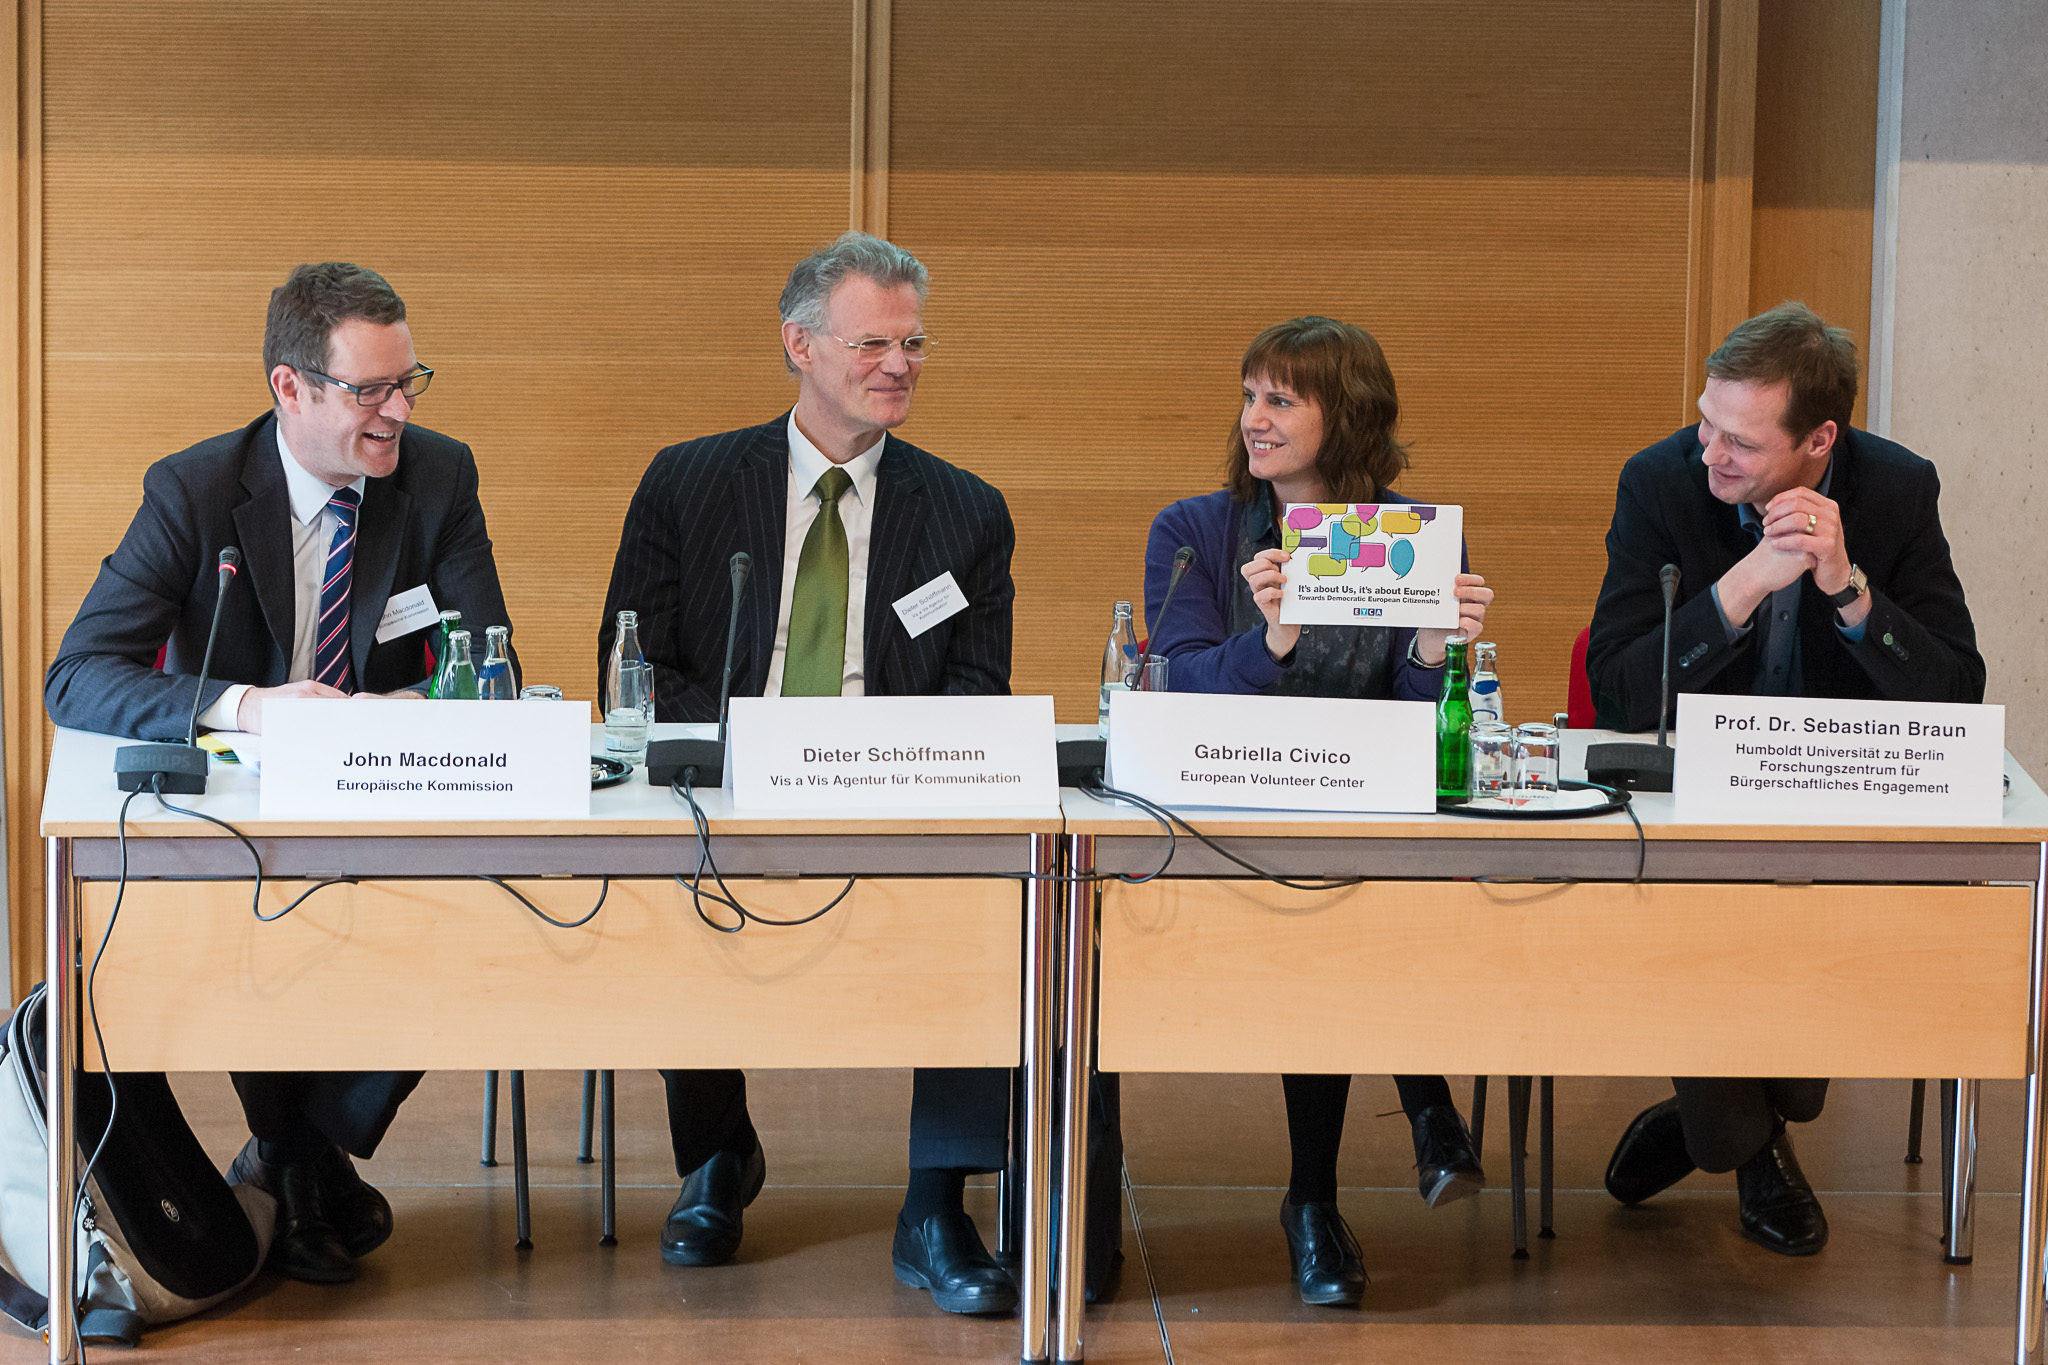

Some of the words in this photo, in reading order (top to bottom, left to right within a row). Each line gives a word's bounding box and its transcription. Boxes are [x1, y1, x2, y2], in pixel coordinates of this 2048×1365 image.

[1314, 585, 1339, 593] about
[1342, 586, 1356, 594] Us,
[1359, 586, 1372, 594] it's
[1375, 586, 1401, 594] about
[1368, 596, 1400, 604] European
[382, 611, 391, 620] ohn
[392, 600, 424, 615] Macdonald
[902, 602, 918, 615] Dieter
[1353, 608, 1382, 616] EYCA
[1715, 715, 1760, 731] Prof.
[1769, 717, 1796, 731] Dr.
[1804, 718, 1900, 735] Sebastian
[1908, 722, 1966, 737] Braun
[344, 752, 391, 766] John
[400, 753, 507, 767] Macdonald
[803, 748, 861, 762] Dieter
[868, 748, 985, 761] Schöffmann
[1195, 745, 1282, 761] Gabriella
[1289, 748, 1351, 764] Civico
[1601, 752, 1662, 767] PHILIPS
[1736, 744, 1802, 756] Humboldt
[1807, 746, 1880, 758] Universität
[1884, 749, 1900, 759] zu
[1905, 749, 1944, 760] Berlin
[129, 754, 191, 769] PHILIPS
[1760, 761, 1896, 775] Forschungszentrum
[1901, 765, 1920, 776] für
[337, 779, 422, 793] Europäische
[428, 780, 513, 792] Kommission
[770, 775, 791, 786] Vis
[796, 777, 803, 786] a
[808, 775, 828, 786] Vis
[833, 775, 887, 788] Agentur
[891, 773, 910, 785] für
[915, 772, 1021, 784] Kommunikation
[1181, 771, 1245, 785] European
[1250, 774, 1315, 786] Volunteer
[1320, 777, 1365, 788] Center
[1730, 776, 1859, 790] Bürgerschaftliches
[1864, 780, 1948, 794] Engagement
